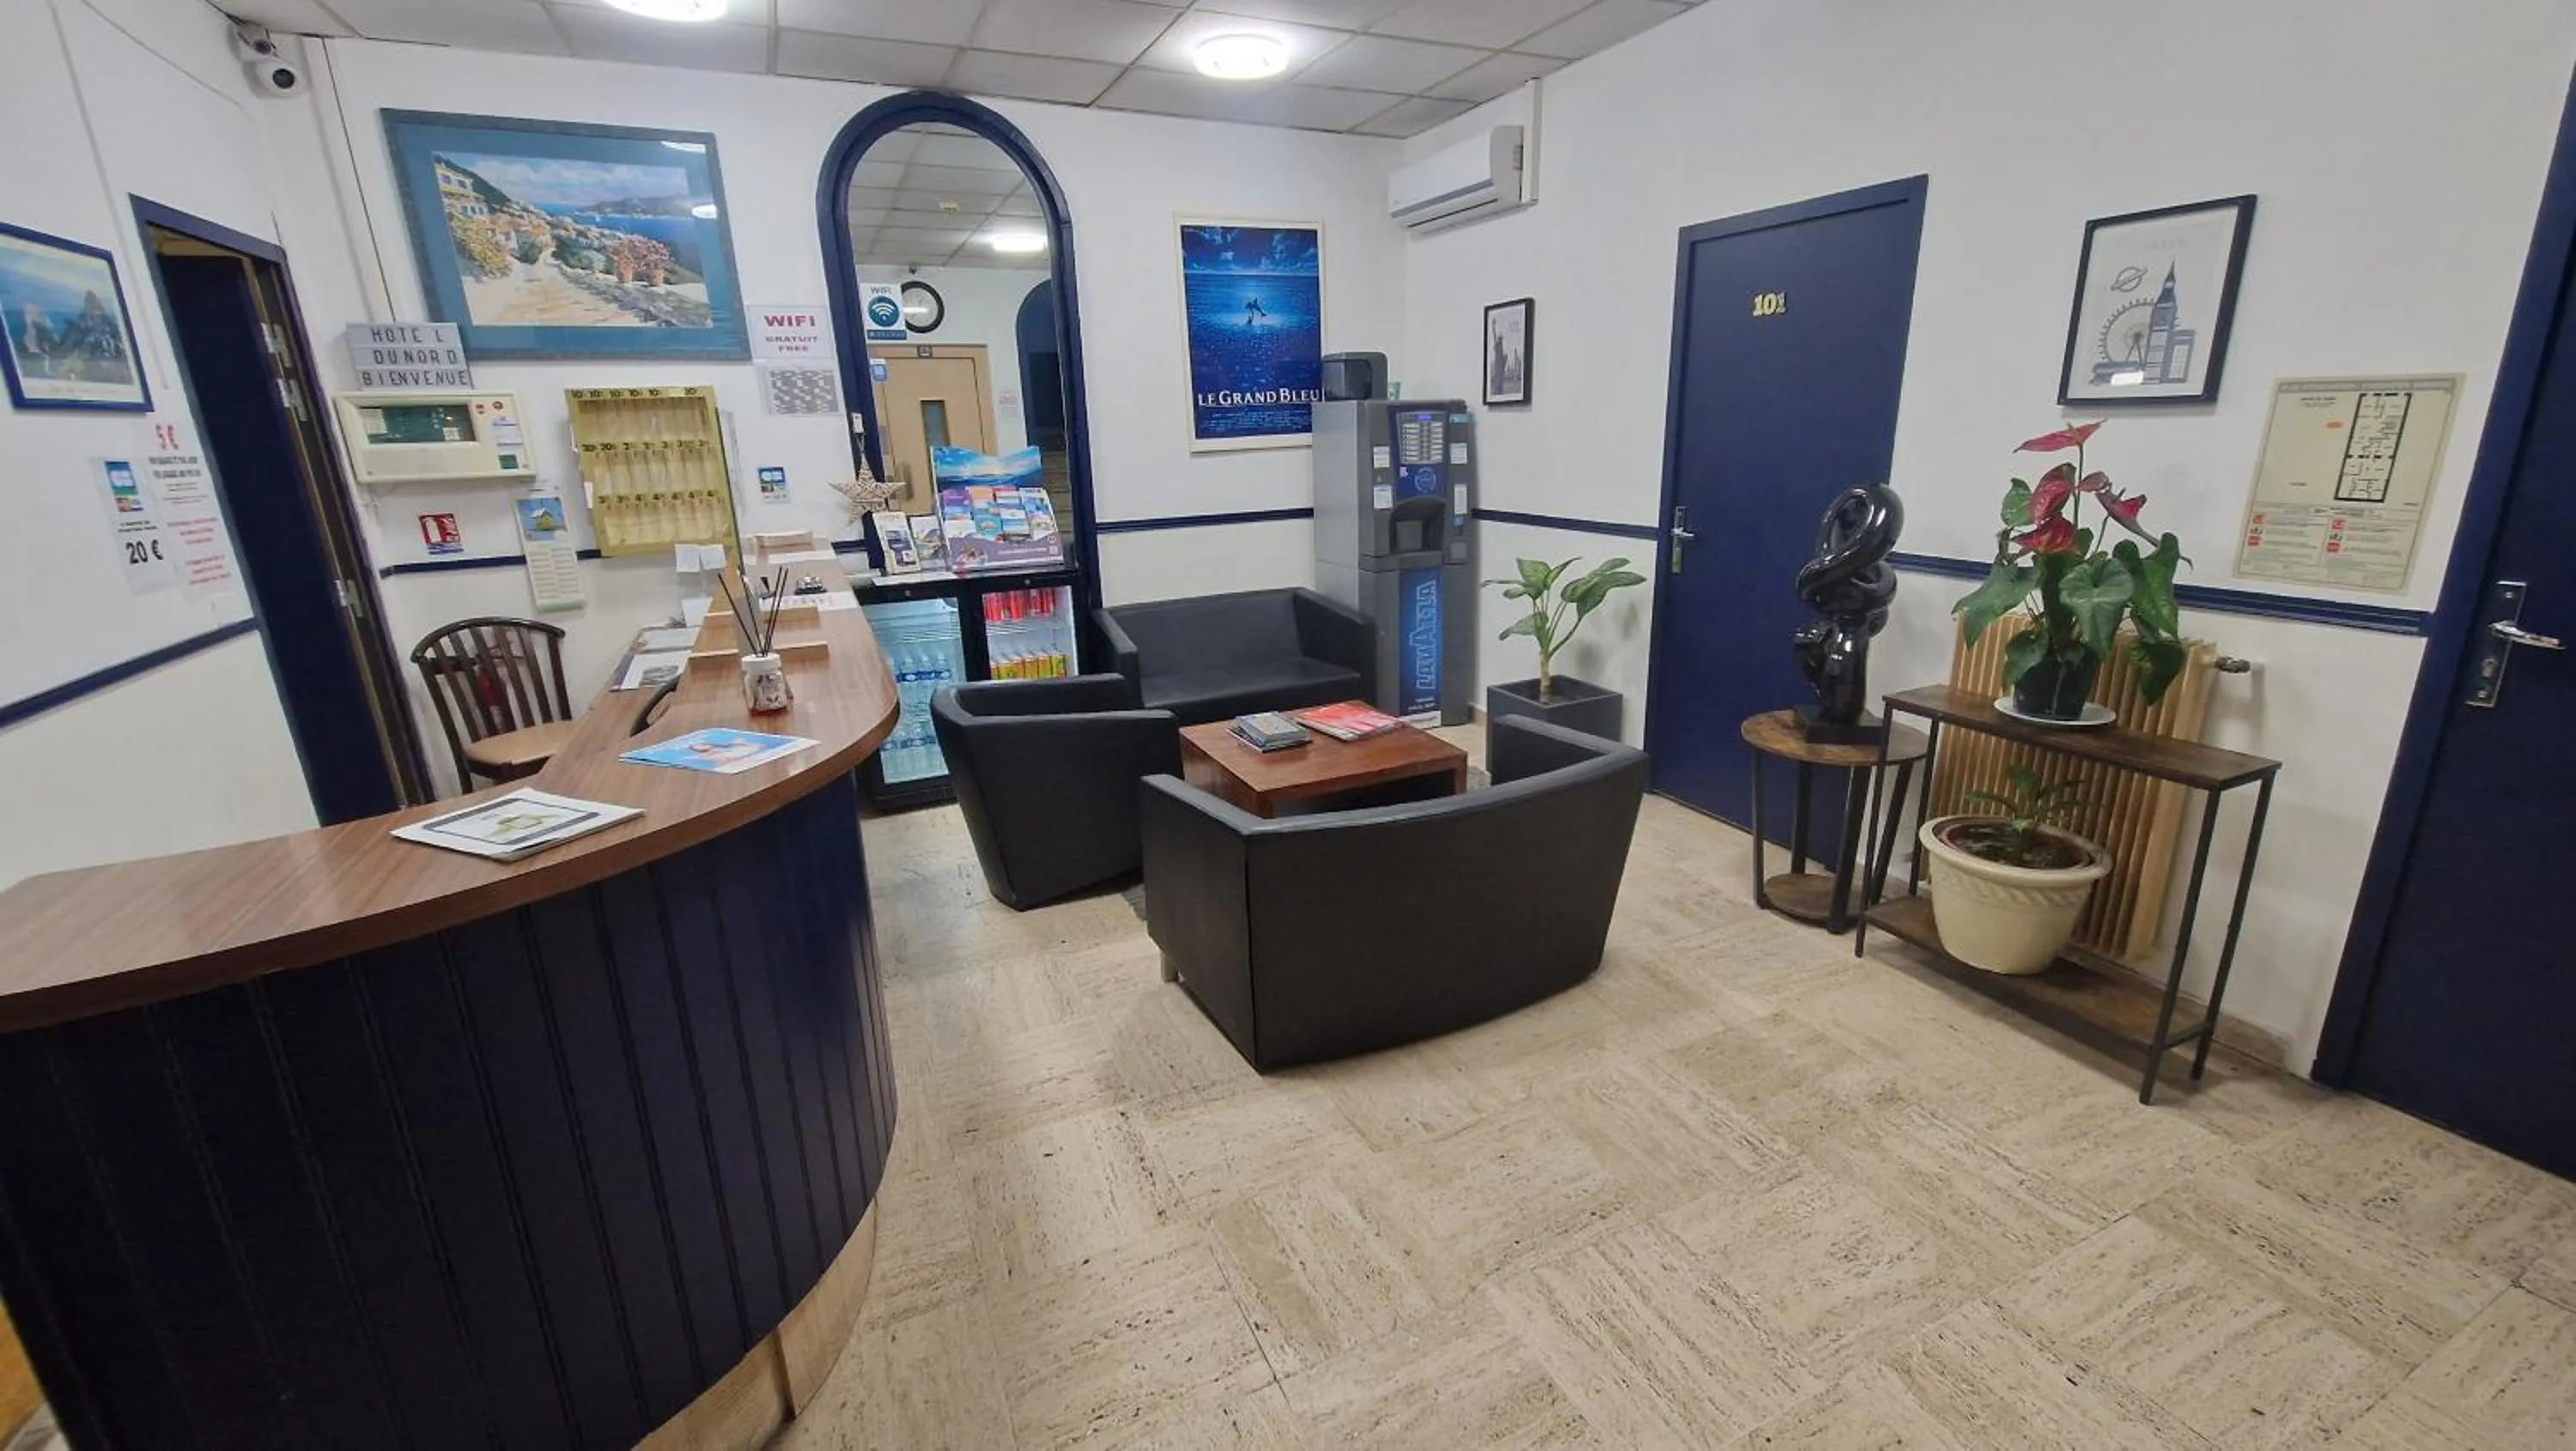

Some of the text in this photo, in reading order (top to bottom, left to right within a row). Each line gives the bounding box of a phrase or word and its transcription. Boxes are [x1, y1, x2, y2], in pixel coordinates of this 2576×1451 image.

[1753, 292, 1786, 317] 101
[763, 314, 816, 327] WIFI
[361, 370, 469, 386] BIENVENUE
[1198, 387, 1320, 406] LE GRAND BLEU
[125, 541, 148, 564] 20
